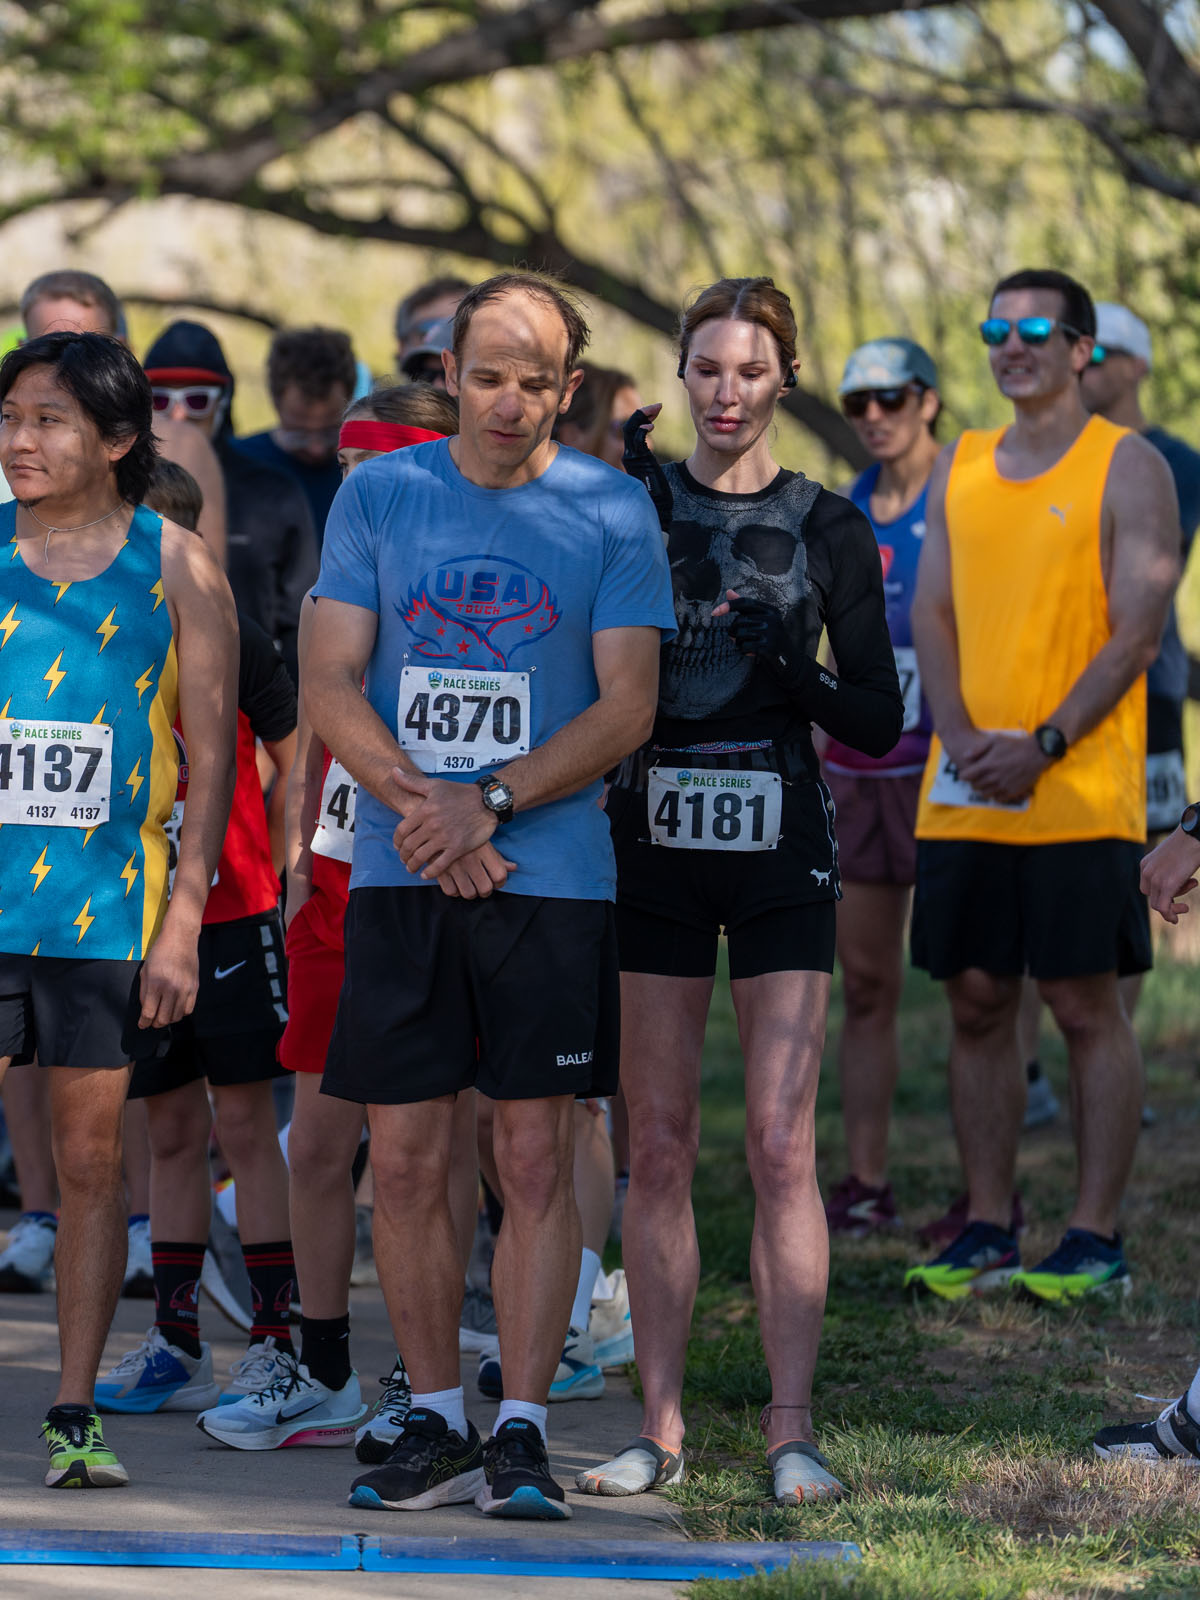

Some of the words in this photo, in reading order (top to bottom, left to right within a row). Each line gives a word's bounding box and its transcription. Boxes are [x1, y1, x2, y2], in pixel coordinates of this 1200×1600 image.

[436, 569, 530, 607] USA
[456, 604, 501, 615] TOUCH
[443, 678, 466, 689] RACE
[468, 679, 501, 691] SERIES
[405, 692, 520, 744] 4370
[24, 728, 48, 739] RACE
[50, 729, 82, 740] SERIES
[443, 756, 474, 768] 4370
[693, 777, 717, 787] RACE
[719, 778, 751, 788] SERIES
[26, 805, 57, 818] 4137
[71, 806, 101, 819] 4137
[655, 790, 765, 841] 4181
